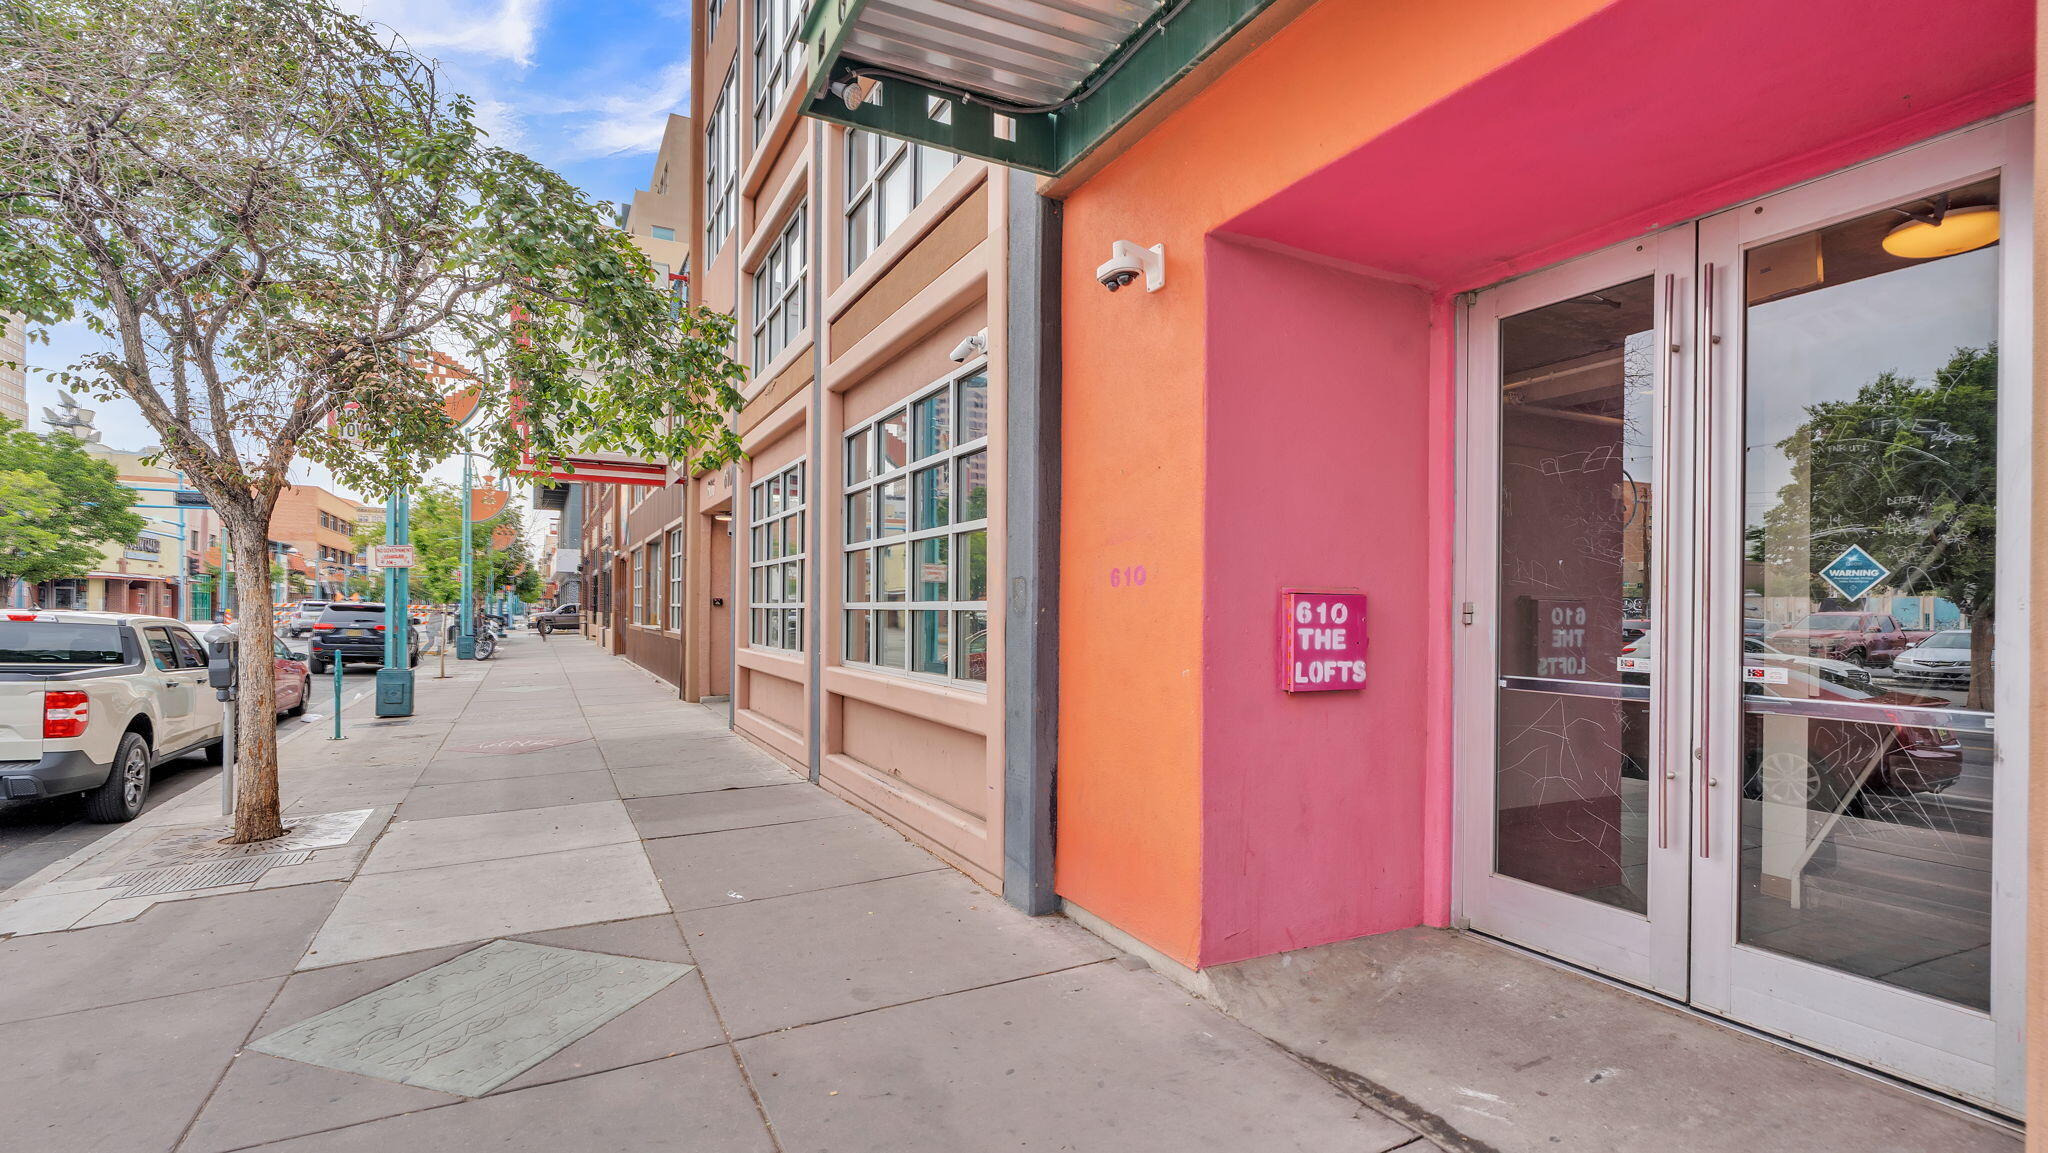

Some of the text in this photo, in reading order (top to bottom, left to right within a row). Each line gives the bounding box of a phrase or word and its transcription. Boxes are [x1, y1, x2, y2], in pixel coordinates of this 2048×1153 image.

[1110, 566, 1147, 587] 610
[1829, 569, 1879, 577] WARNING
[1296, 601, 1348, 624] 610
[1297, 628, 1346, 650] THE
[1295, 660, 1366, 683] LOFTS
